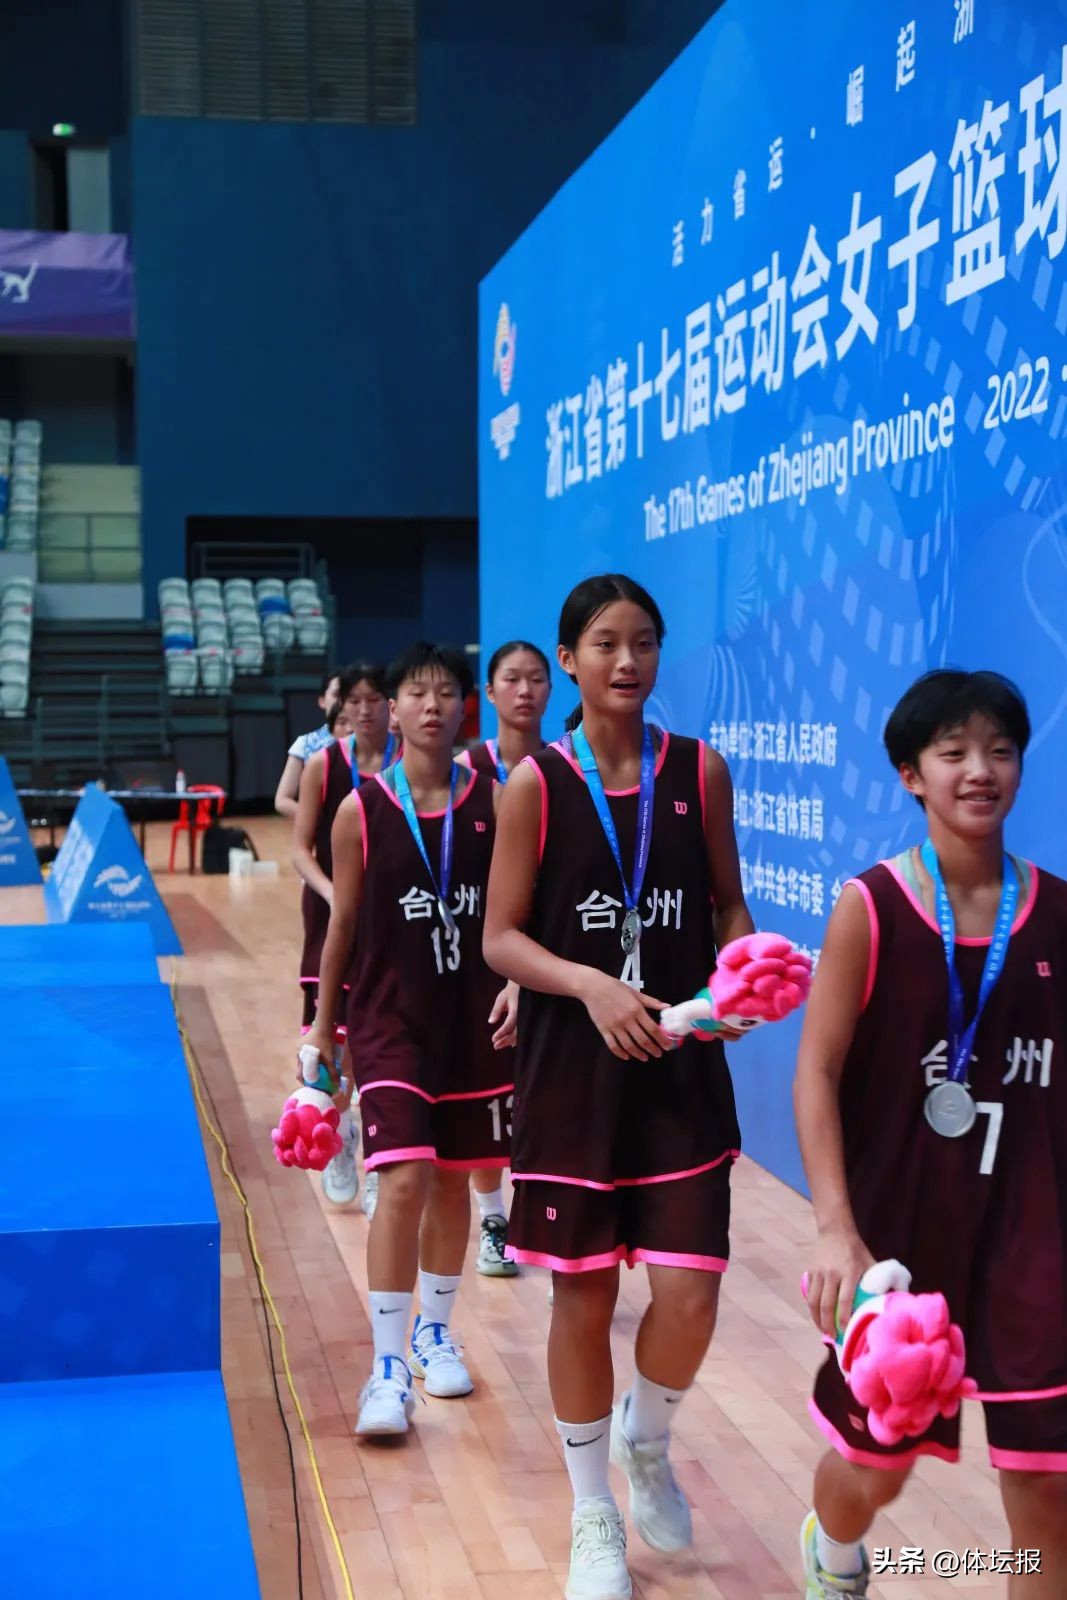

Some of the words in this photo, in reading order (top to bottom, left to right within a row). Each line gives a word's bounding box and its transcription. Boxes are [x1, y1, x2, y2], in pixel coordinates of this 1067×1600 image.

[545, 44, 1067, 498] 浙江省第十七届运动会女子篮球
[644, 494, 666, 541] The
[668, 480, 695, 534] 17th
[696, 474, 745, 525] Games
[748, 455, 766, 509] of
[768, 431, 849, 507] Zhejiang
[852, 391, 956, 477] Province
[983, 355, 1050, 430] 2022
[399, 883, 481, 921] 台州
[576, 887, 682, 931] 台州
[431, 926, 461, 974] 13
[620, 942, 645, 992] 4
[975, 1101, 1004, 1175] 7
